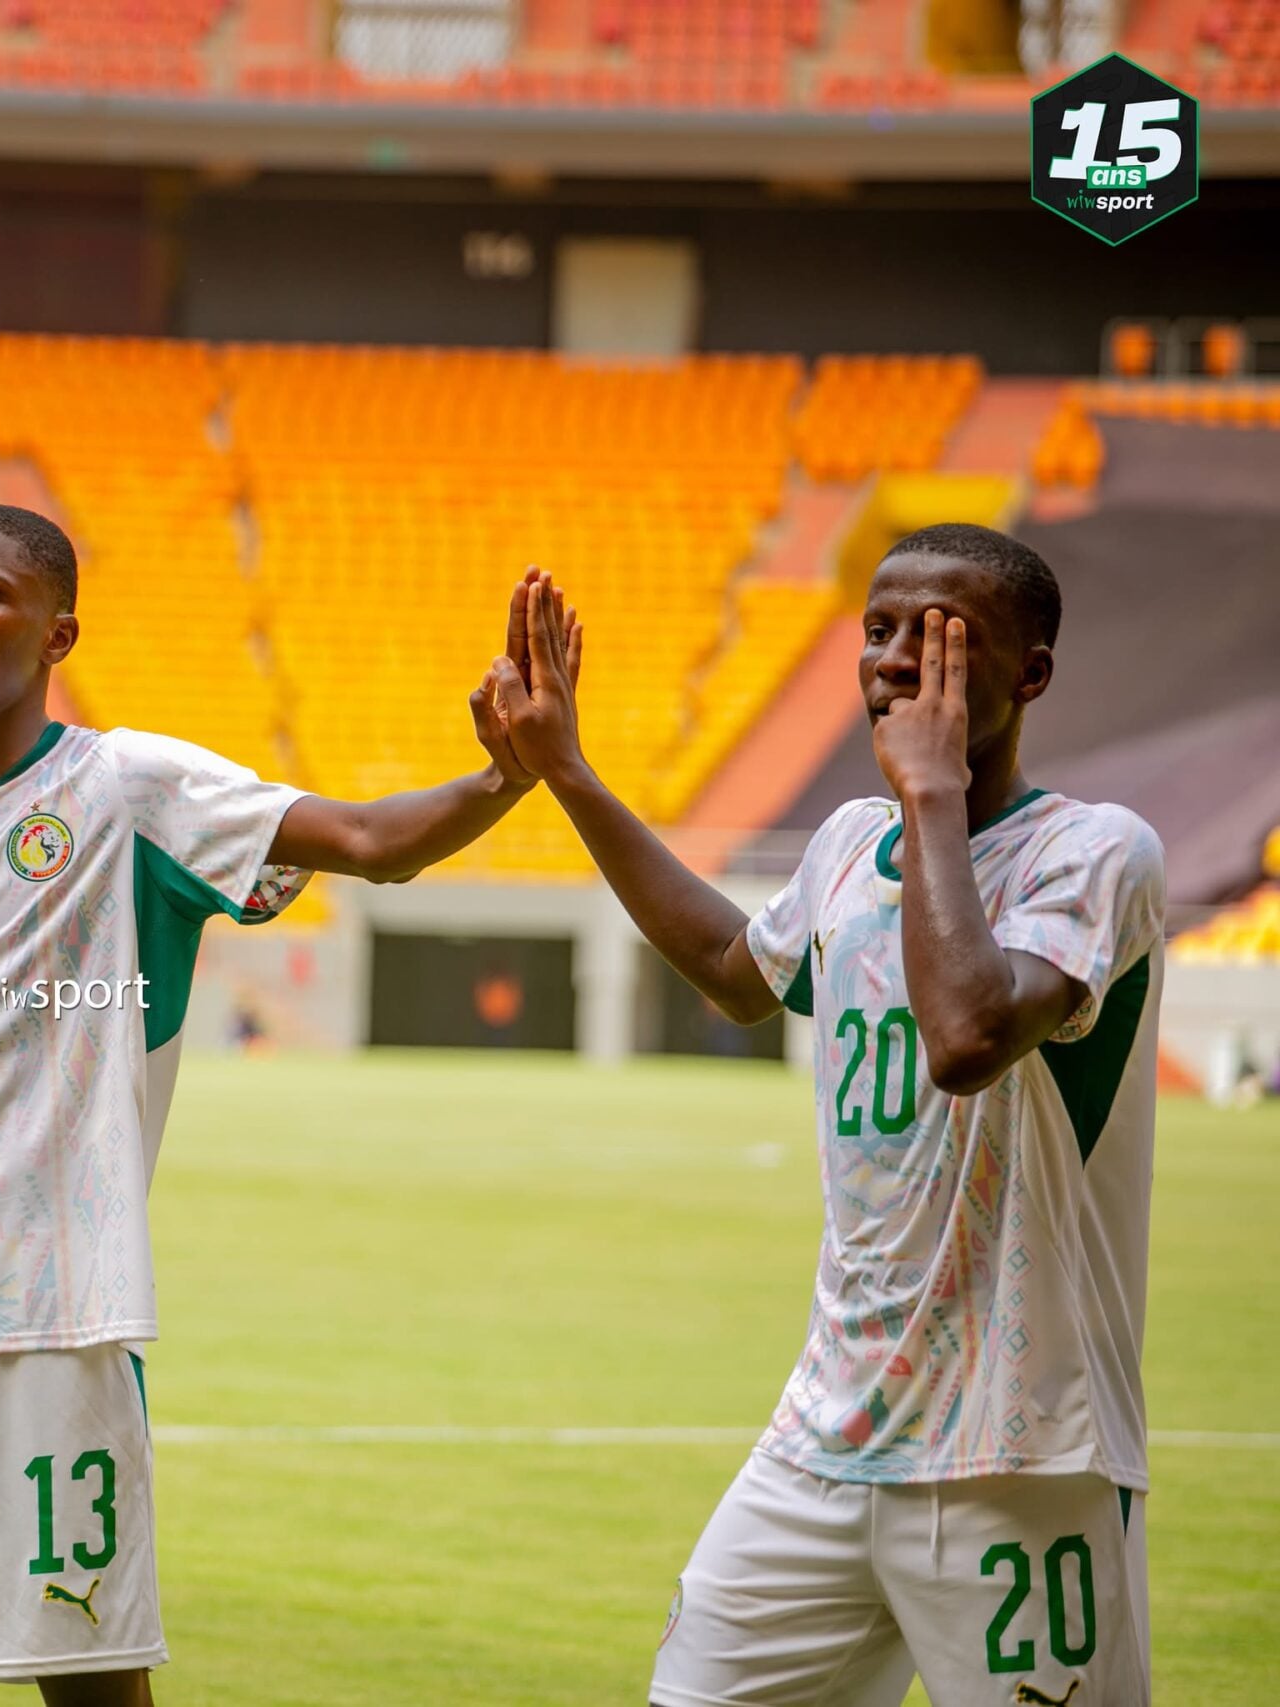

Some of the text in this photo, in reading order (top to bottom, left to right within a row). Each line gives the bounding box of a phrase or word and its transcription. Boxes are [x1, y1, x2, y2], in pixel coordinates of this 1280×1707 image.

[835, 1006, 917, 1137] 20
[24, 1448, 117, 1575] 13
[980, 1533, 1096, 1674] 20
